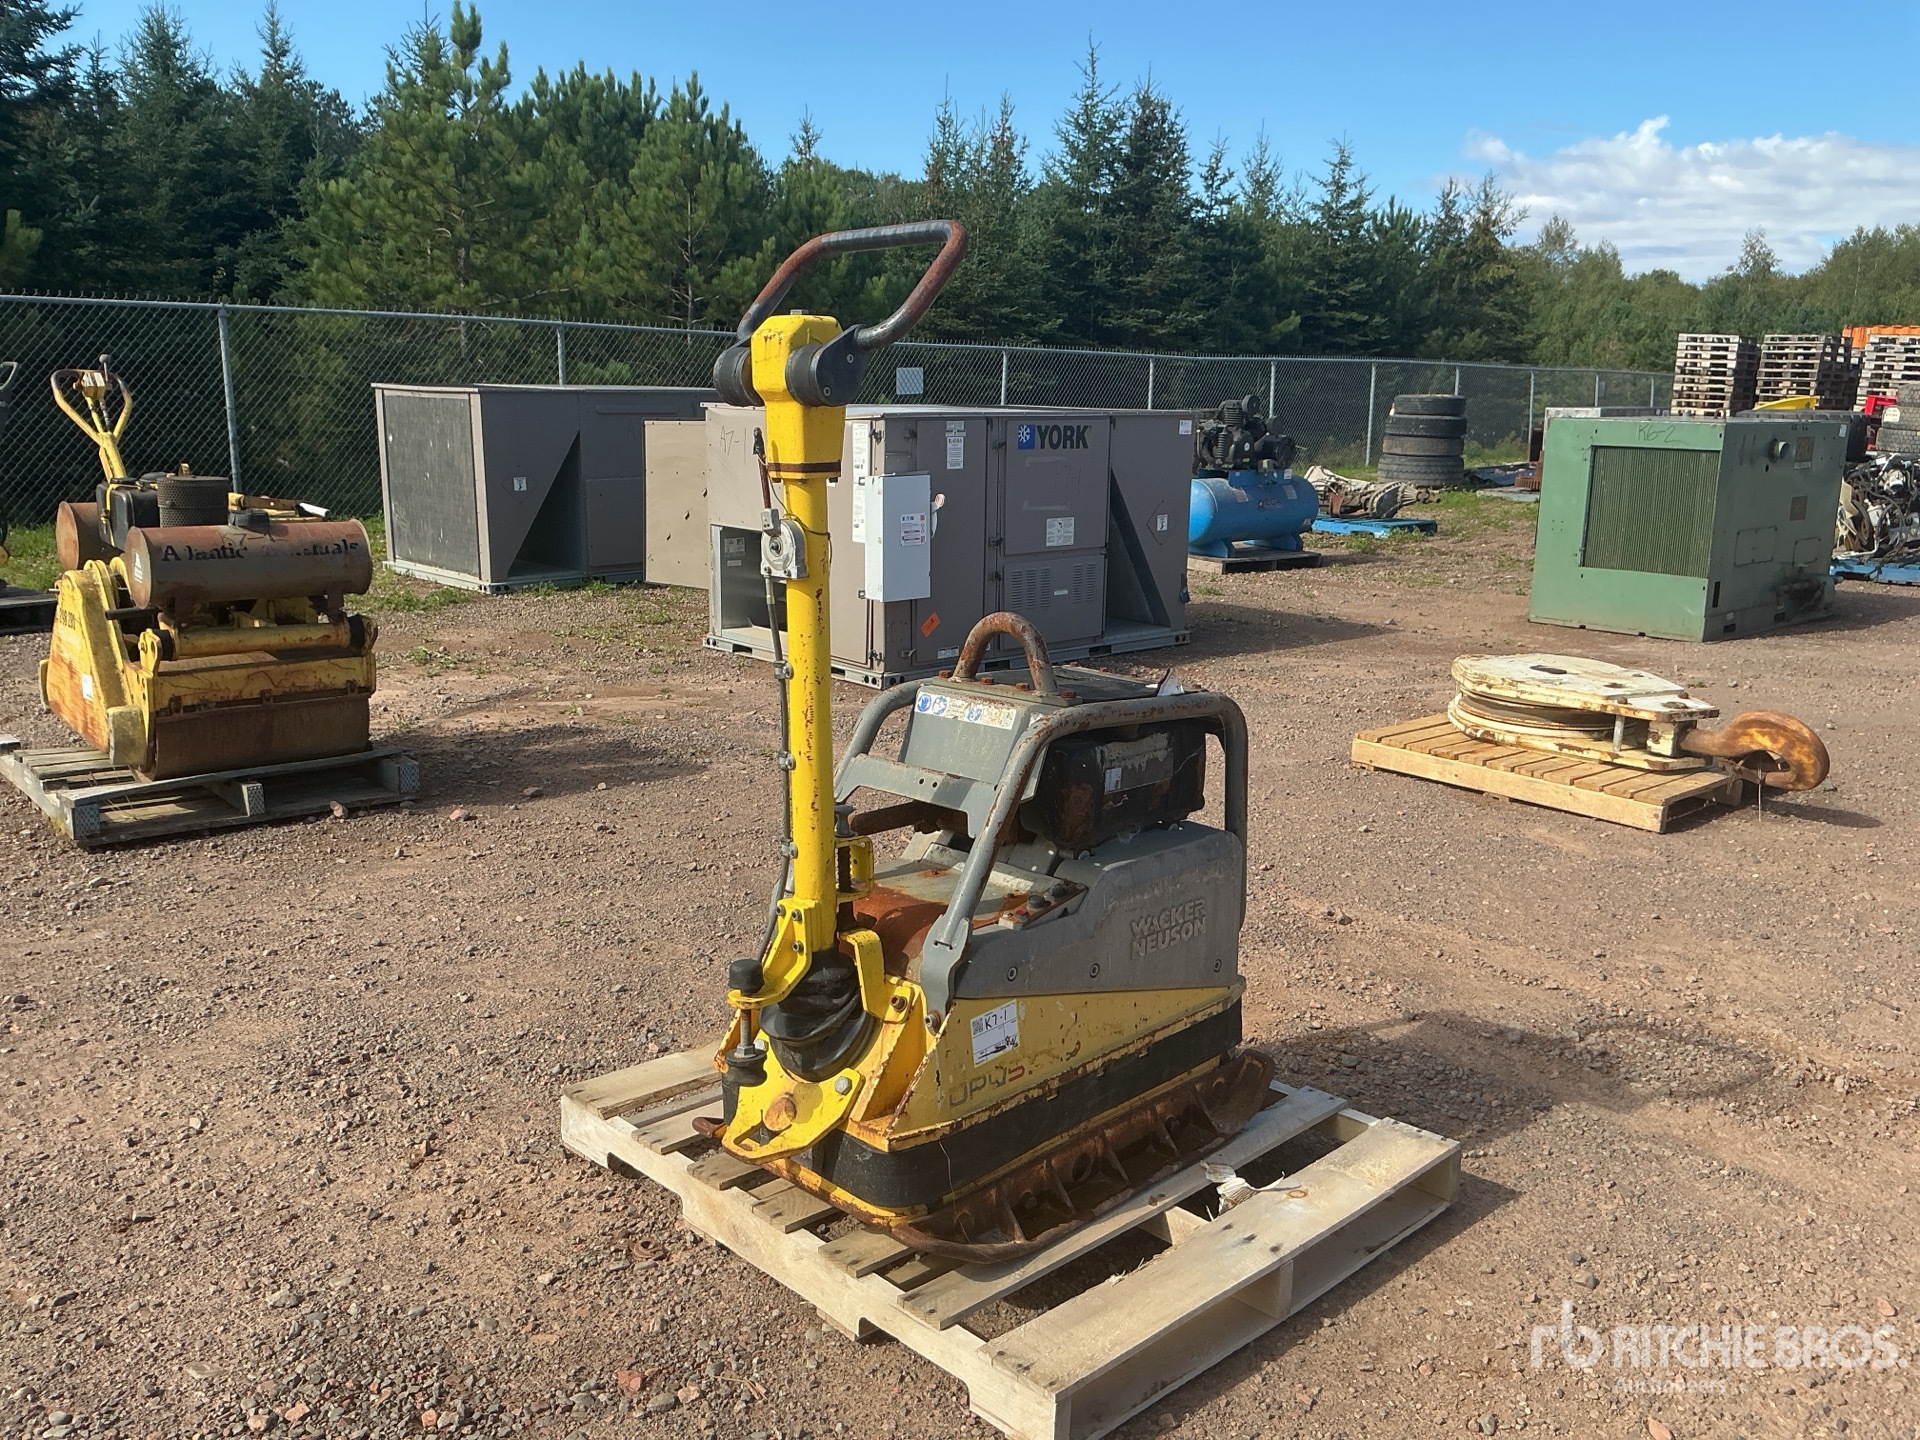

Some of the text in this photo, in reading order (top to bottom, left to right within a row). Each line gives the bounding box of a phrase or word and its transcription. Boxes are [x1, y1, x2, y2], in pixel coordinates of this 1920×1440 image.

[1036, 425, 1089, 449] YORK
[162, 543, 248, 561] Alantic
[1131, 898, 1206, 938] WACKER
[1131, 916, 1206, 960] NEUSON
[985, 1009, 1007, 1030] K7-1
